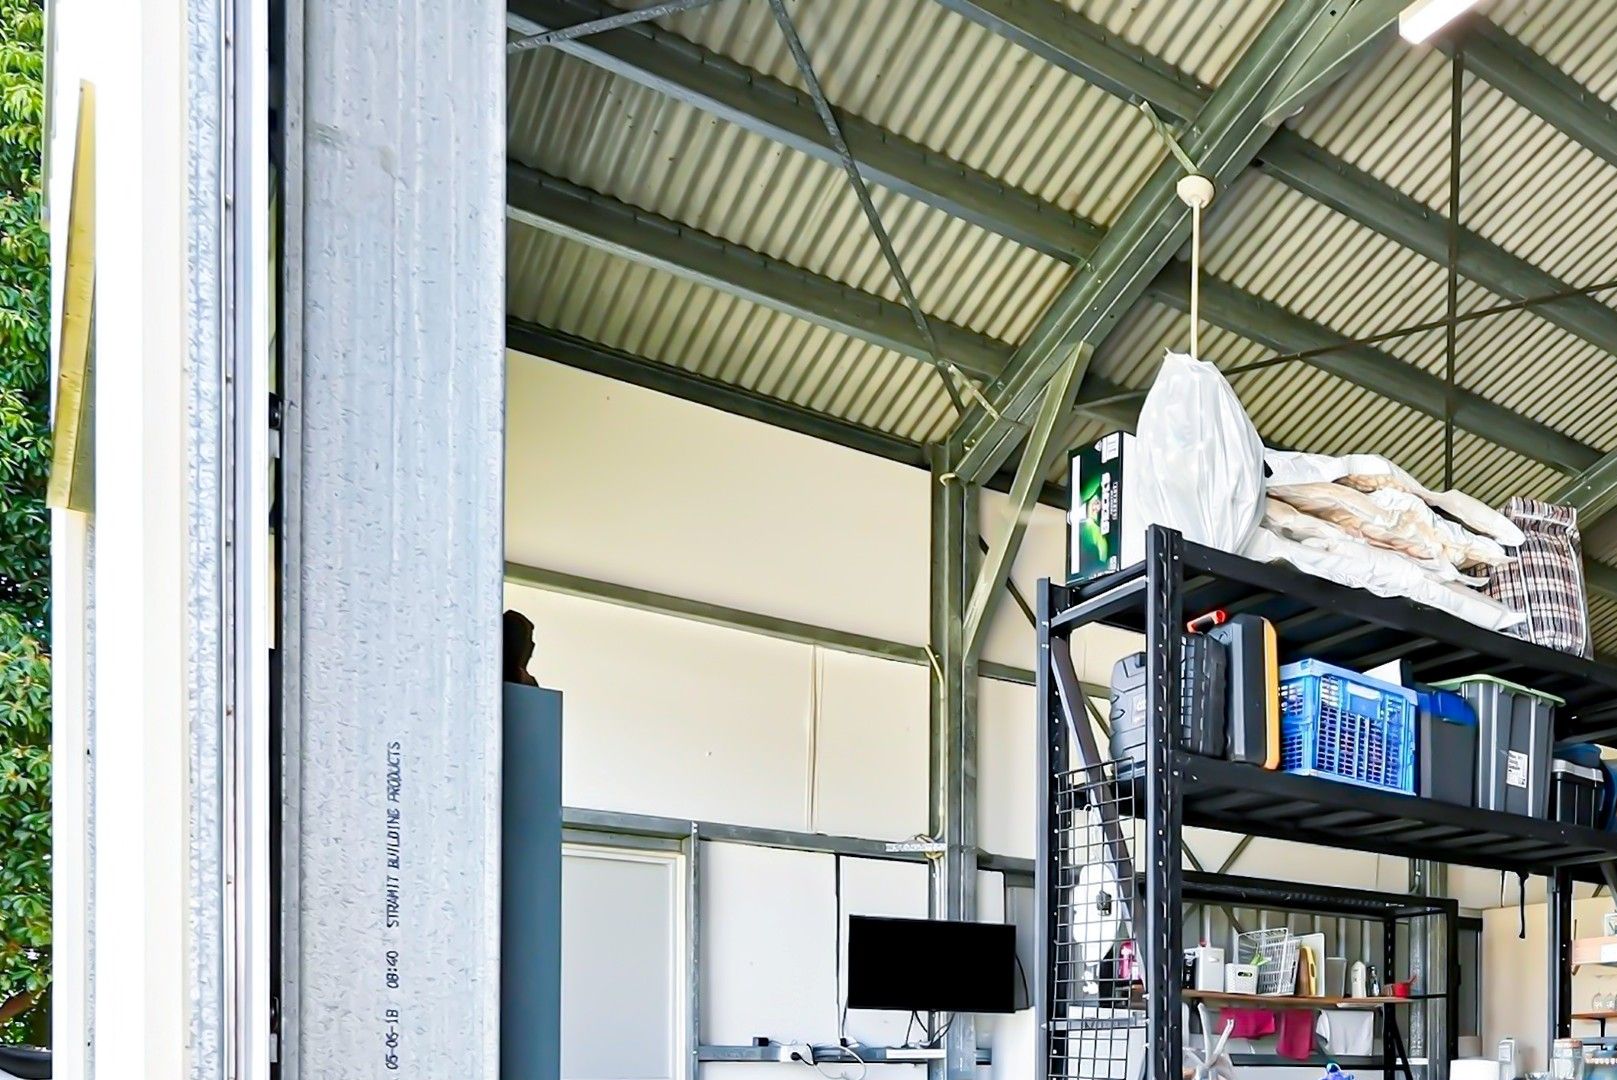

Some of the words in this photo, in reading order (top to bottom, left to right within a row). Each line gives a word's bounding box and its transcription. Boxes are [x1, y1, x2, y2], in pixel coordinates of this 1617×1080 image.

[387, 741, 401, 803] PRODUCTS
[387, 808, 400, 870] BUILDING
[386, 875, 400, 929] STRAMIT
[386, 950, 399, 989] 08:40
